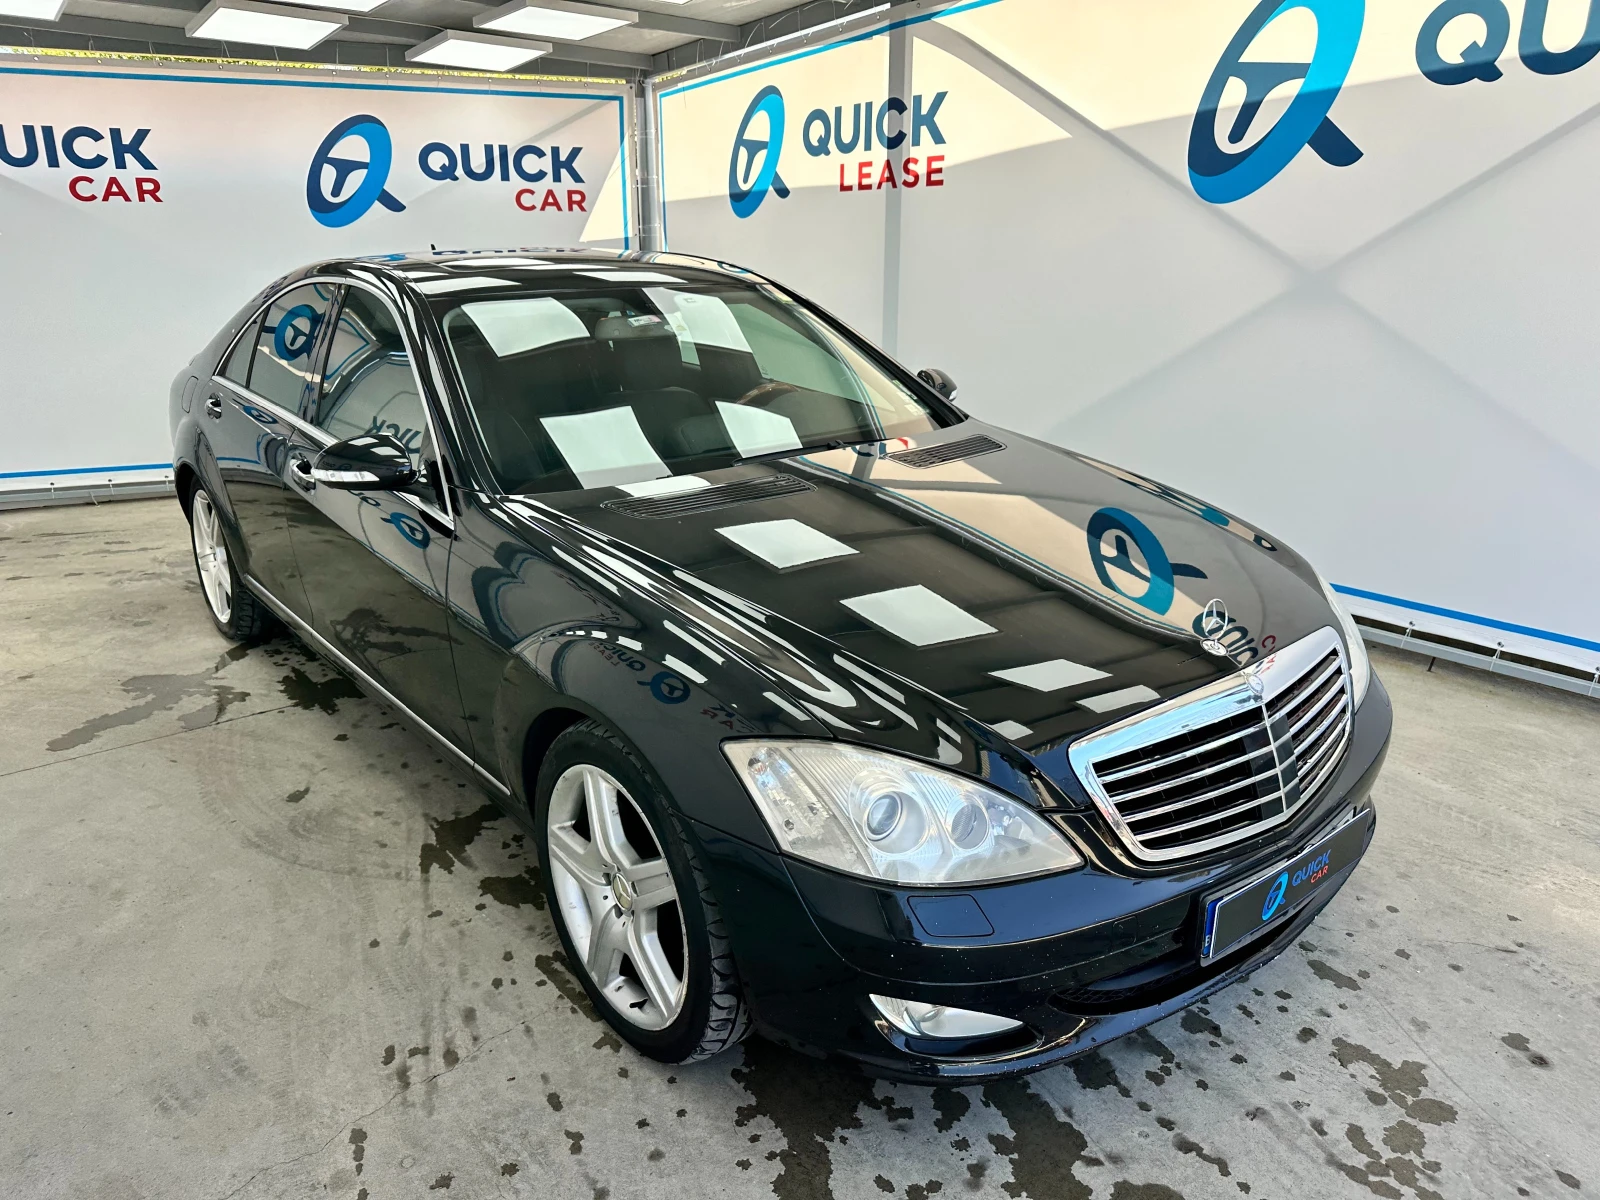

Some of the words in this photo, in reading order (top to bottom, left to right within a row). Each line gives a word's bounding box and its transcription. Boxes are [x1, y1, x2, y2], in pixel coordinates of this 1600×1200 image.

[803, 91, 949, 157] QUICK
[418, 142, 586, 184] QUICK
[839, 155, 946, 192] LEASE
[68, 175, 164, 203] CAR
[515, 188, 588, 212] CAR
[1292, 849, 1331, 886] QUICK
[1310, 865, 1329, 883] CAR
